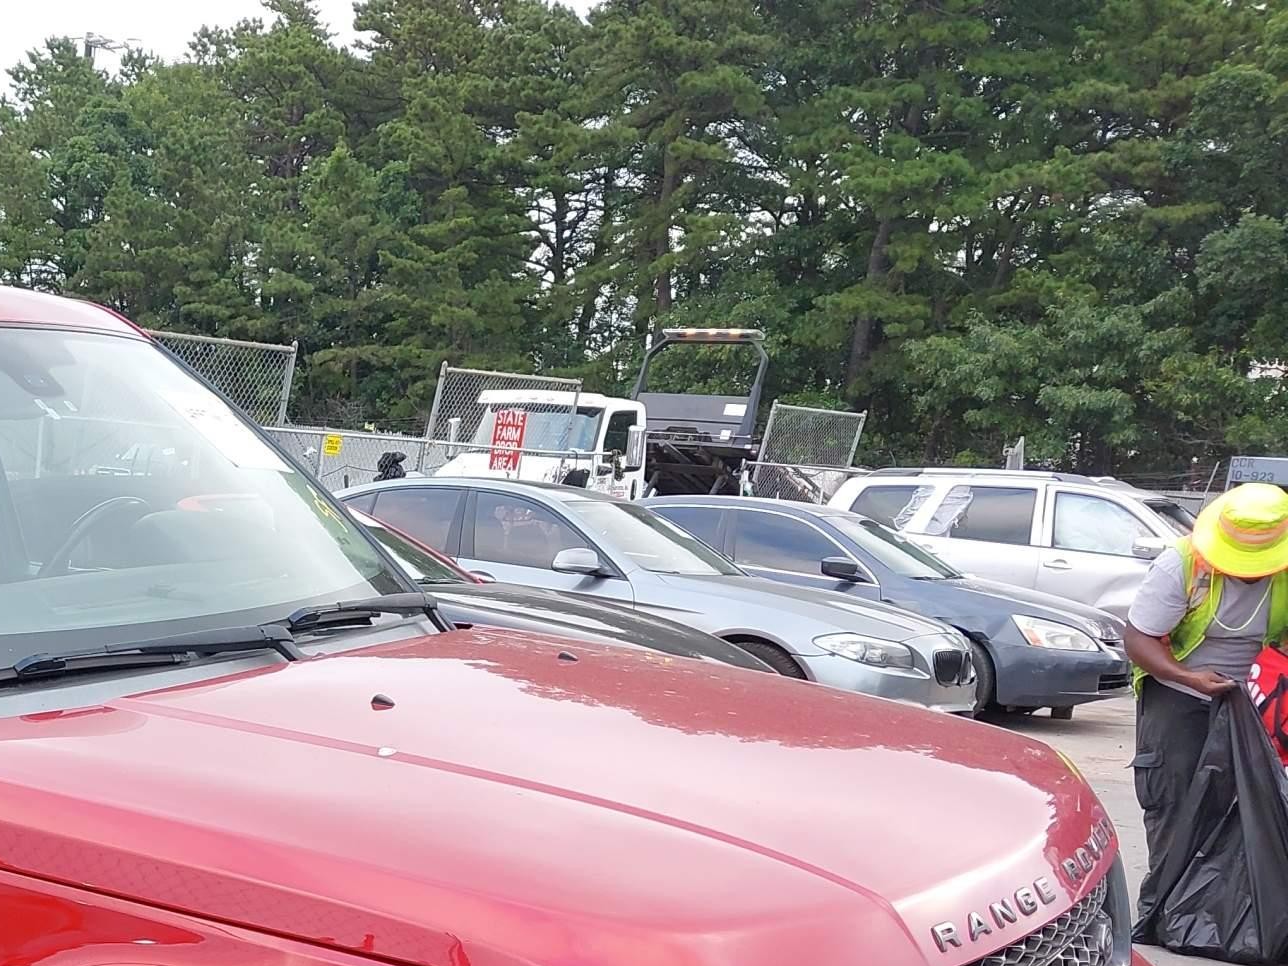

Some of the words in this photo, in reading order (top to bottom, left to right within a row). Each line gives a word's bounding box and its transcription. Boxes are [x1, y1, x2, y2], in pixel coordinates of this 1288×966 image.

[497, 409, 525, 426] STATE
[495, 425, 522, 442] FARM
[492, 456, 515, 471] AREA
[1231, 457, 1255, 468] CCR
[1231, 470, 1275, 482] 10-923
[930, 875, 1058, 953] RANGE
[1061, 817, 1114, 881] ROVER
